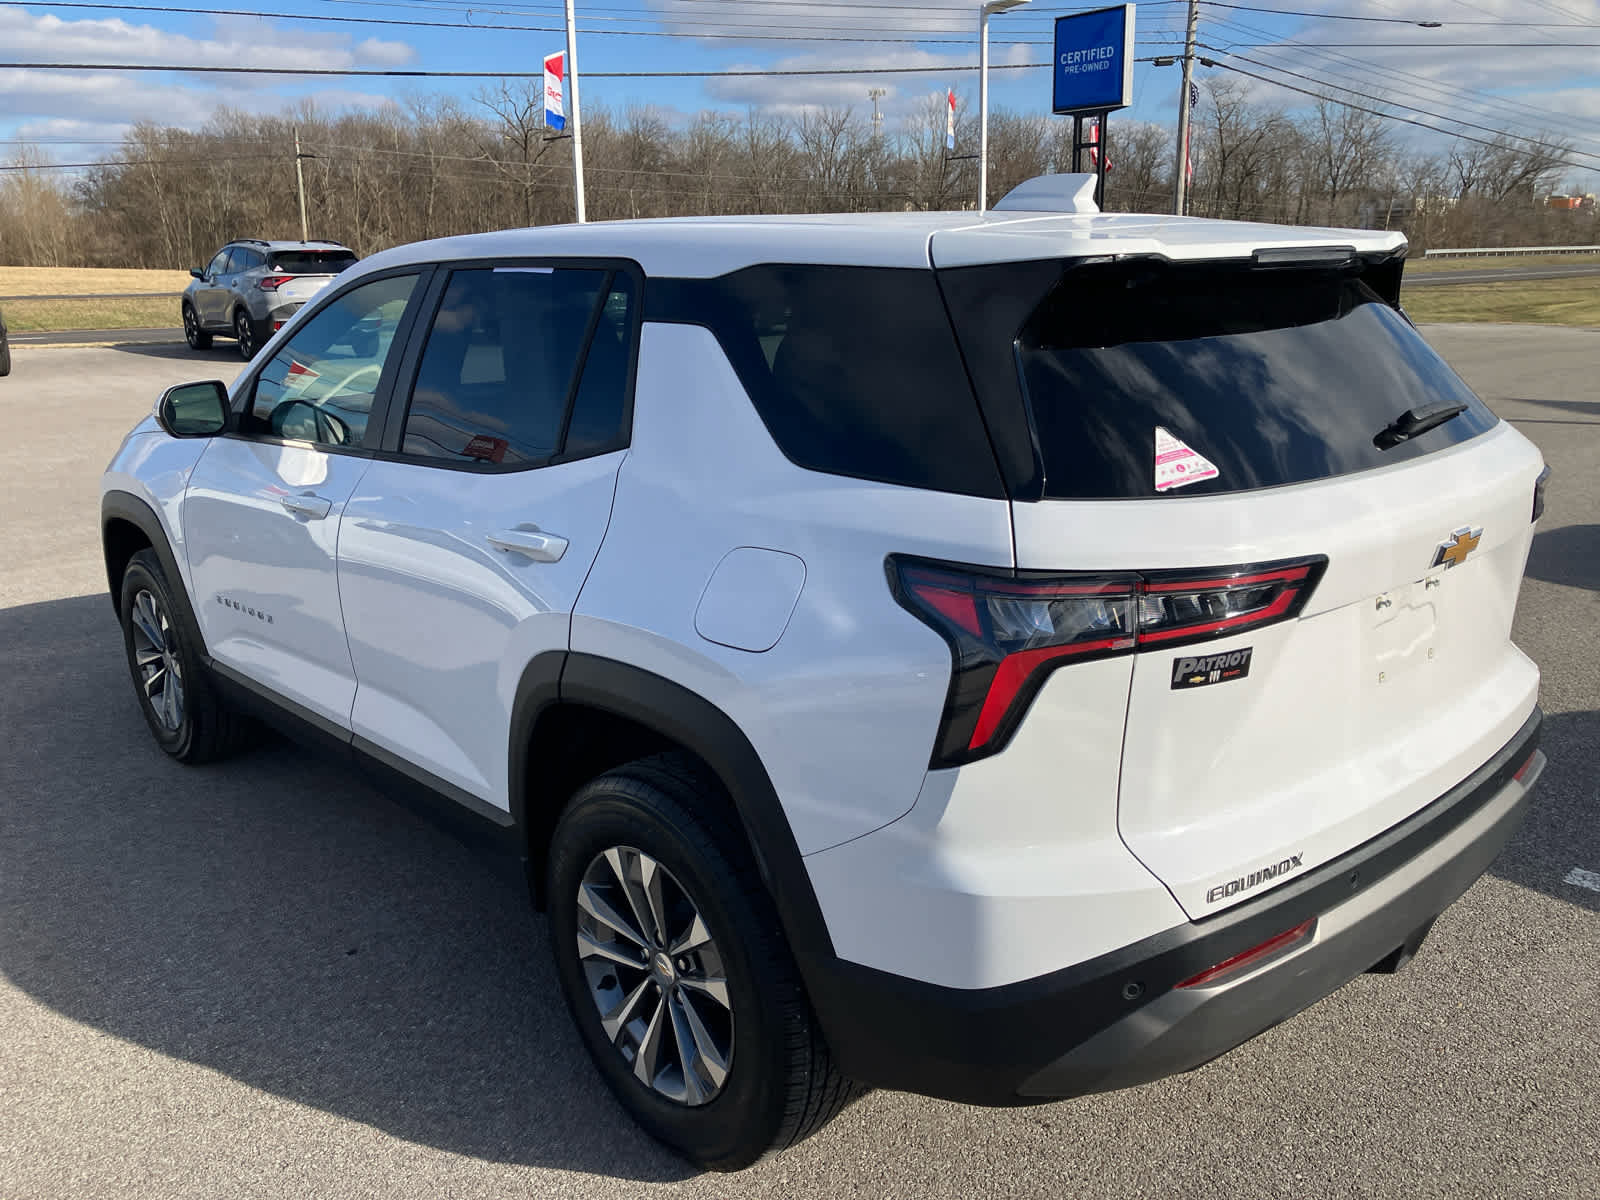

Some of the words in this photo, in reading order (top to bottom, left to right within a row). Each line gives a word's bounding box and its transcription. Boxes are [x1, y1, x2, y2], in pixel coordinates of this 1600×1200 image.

[1060, 46, 1115, 65] CERTIFIED
[1064, 60, 1110, 75] PRE-OWNED
[1173, 649, 1253, 683] PATRIOT
[1206, 850, 1304, 904] EQUINOX
